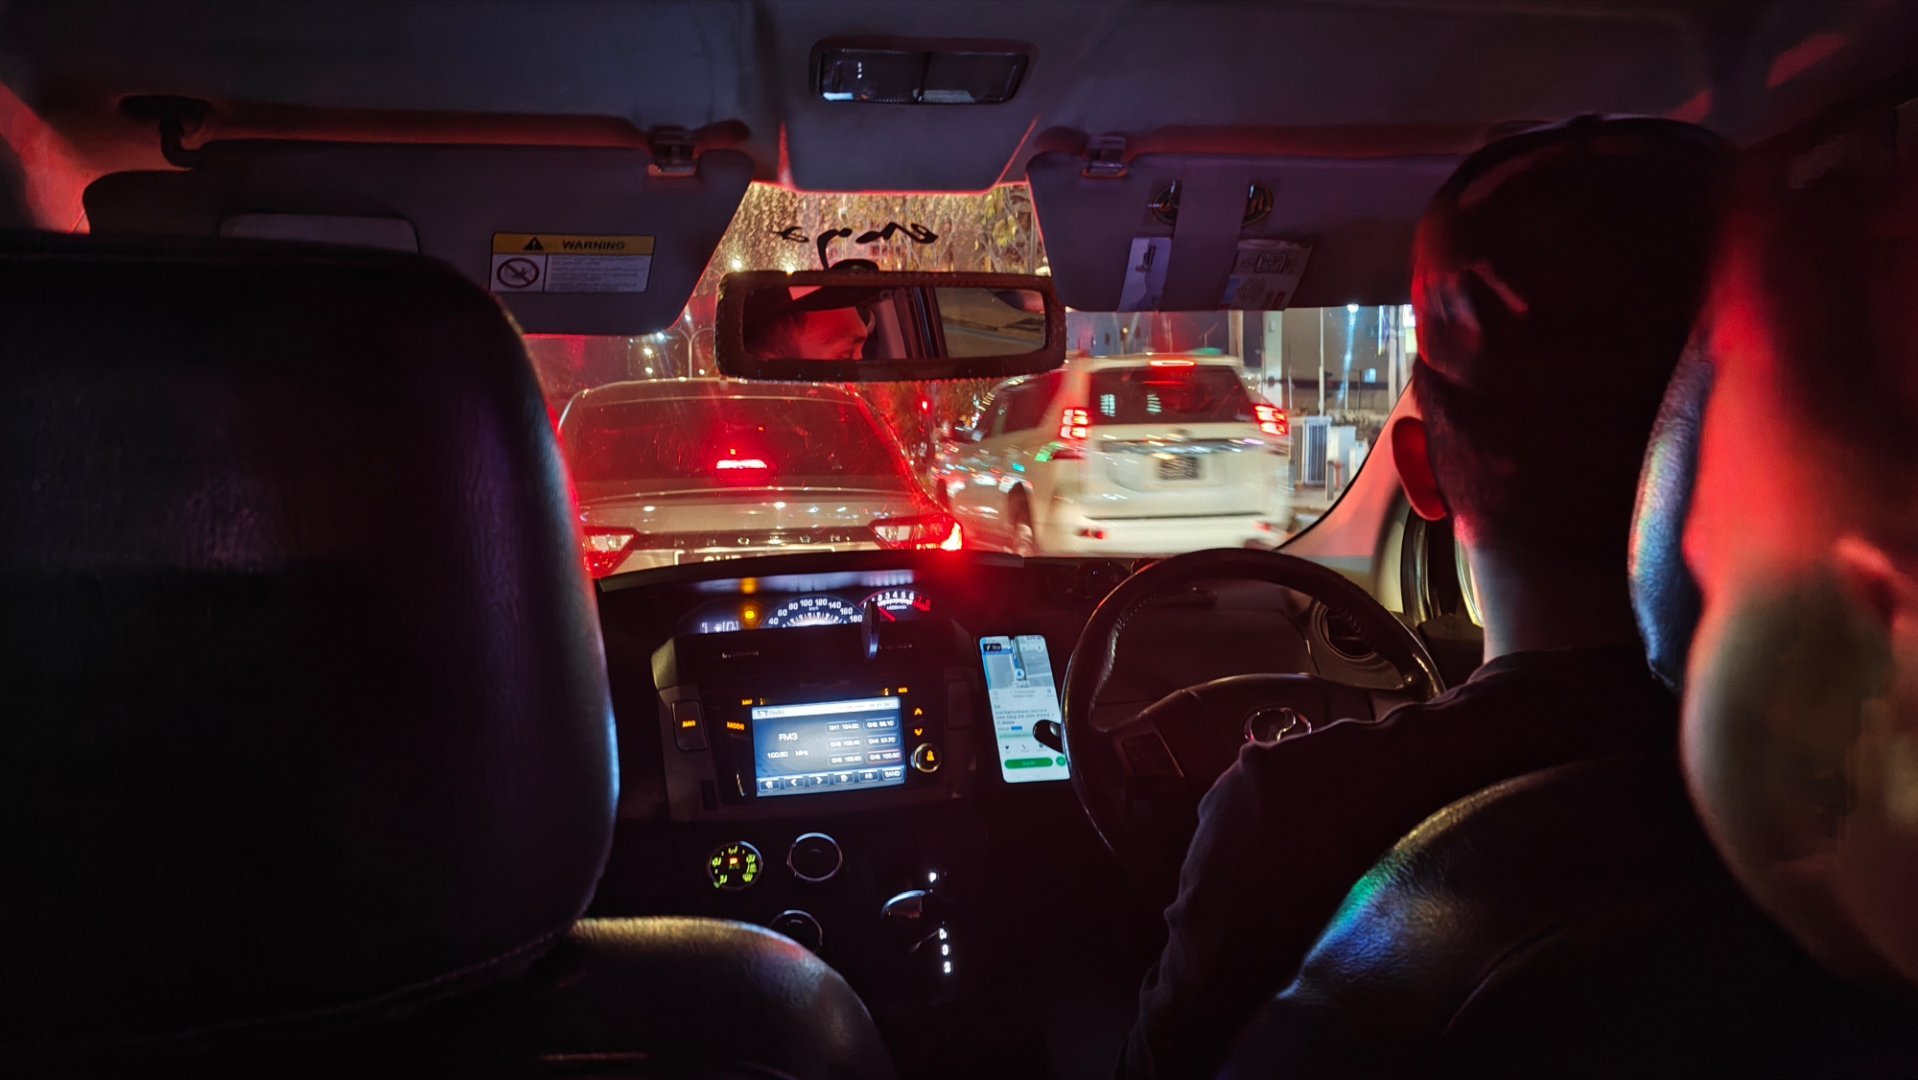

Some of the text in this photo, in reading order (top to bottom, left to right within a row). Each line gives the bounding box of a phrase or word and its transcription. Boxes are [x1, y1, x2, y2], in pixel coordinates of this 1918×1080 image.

[561, 239, 625, 250] WARNING
[778, 609, 788, 617] 60
[788, 602, 798, 610] 80
[800, 599, 813, 607] 100
[815, 598, 828, 606] 120
[828, 601, 841, 609] 140
[840, 607, 853, 615] 160
[778, 732, 798, 741] FM3
[885, 768, 901, 780] BAND
